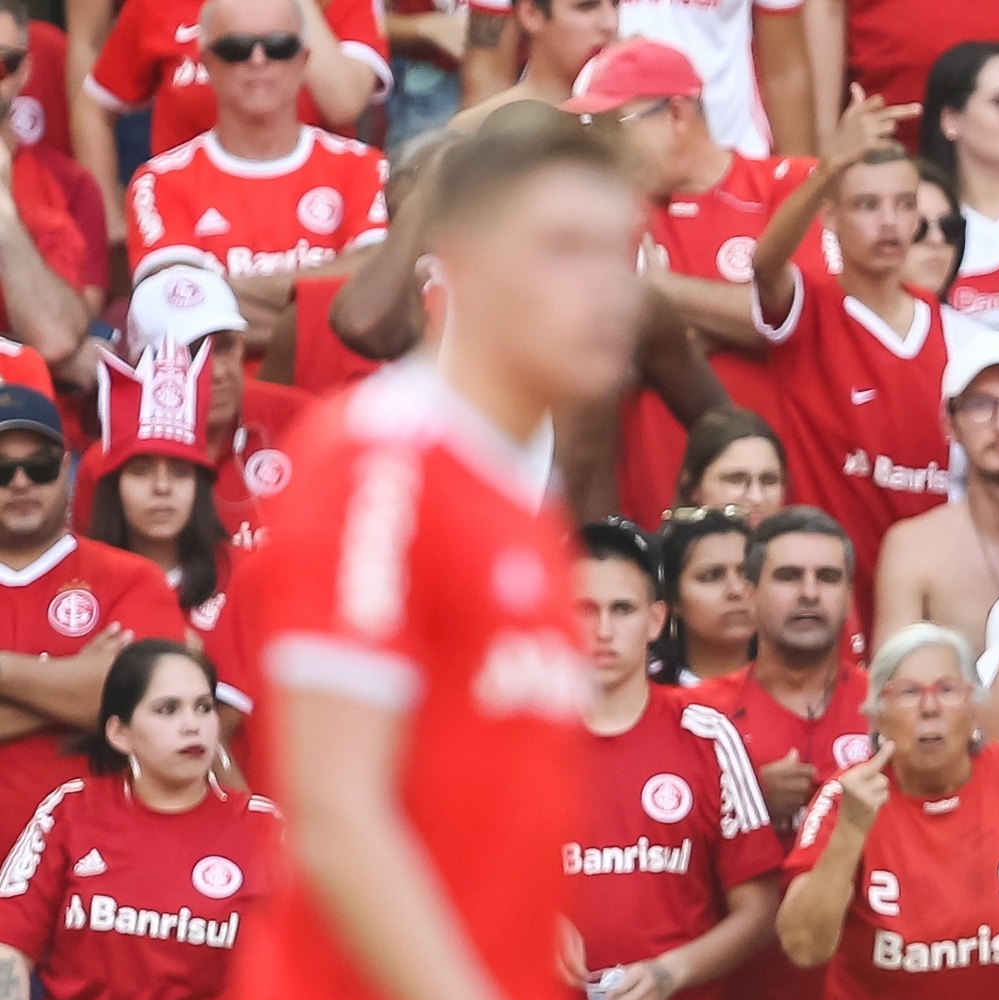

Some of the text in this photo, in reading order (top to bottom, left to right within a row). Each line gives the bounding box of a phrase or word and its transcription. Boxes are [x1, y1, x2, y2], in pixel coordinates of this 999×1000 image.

[560, 835, 693, 877] Banrisul
[867, 868, 901, 917] 2
[90, 893, 240, 950] Banrisul
